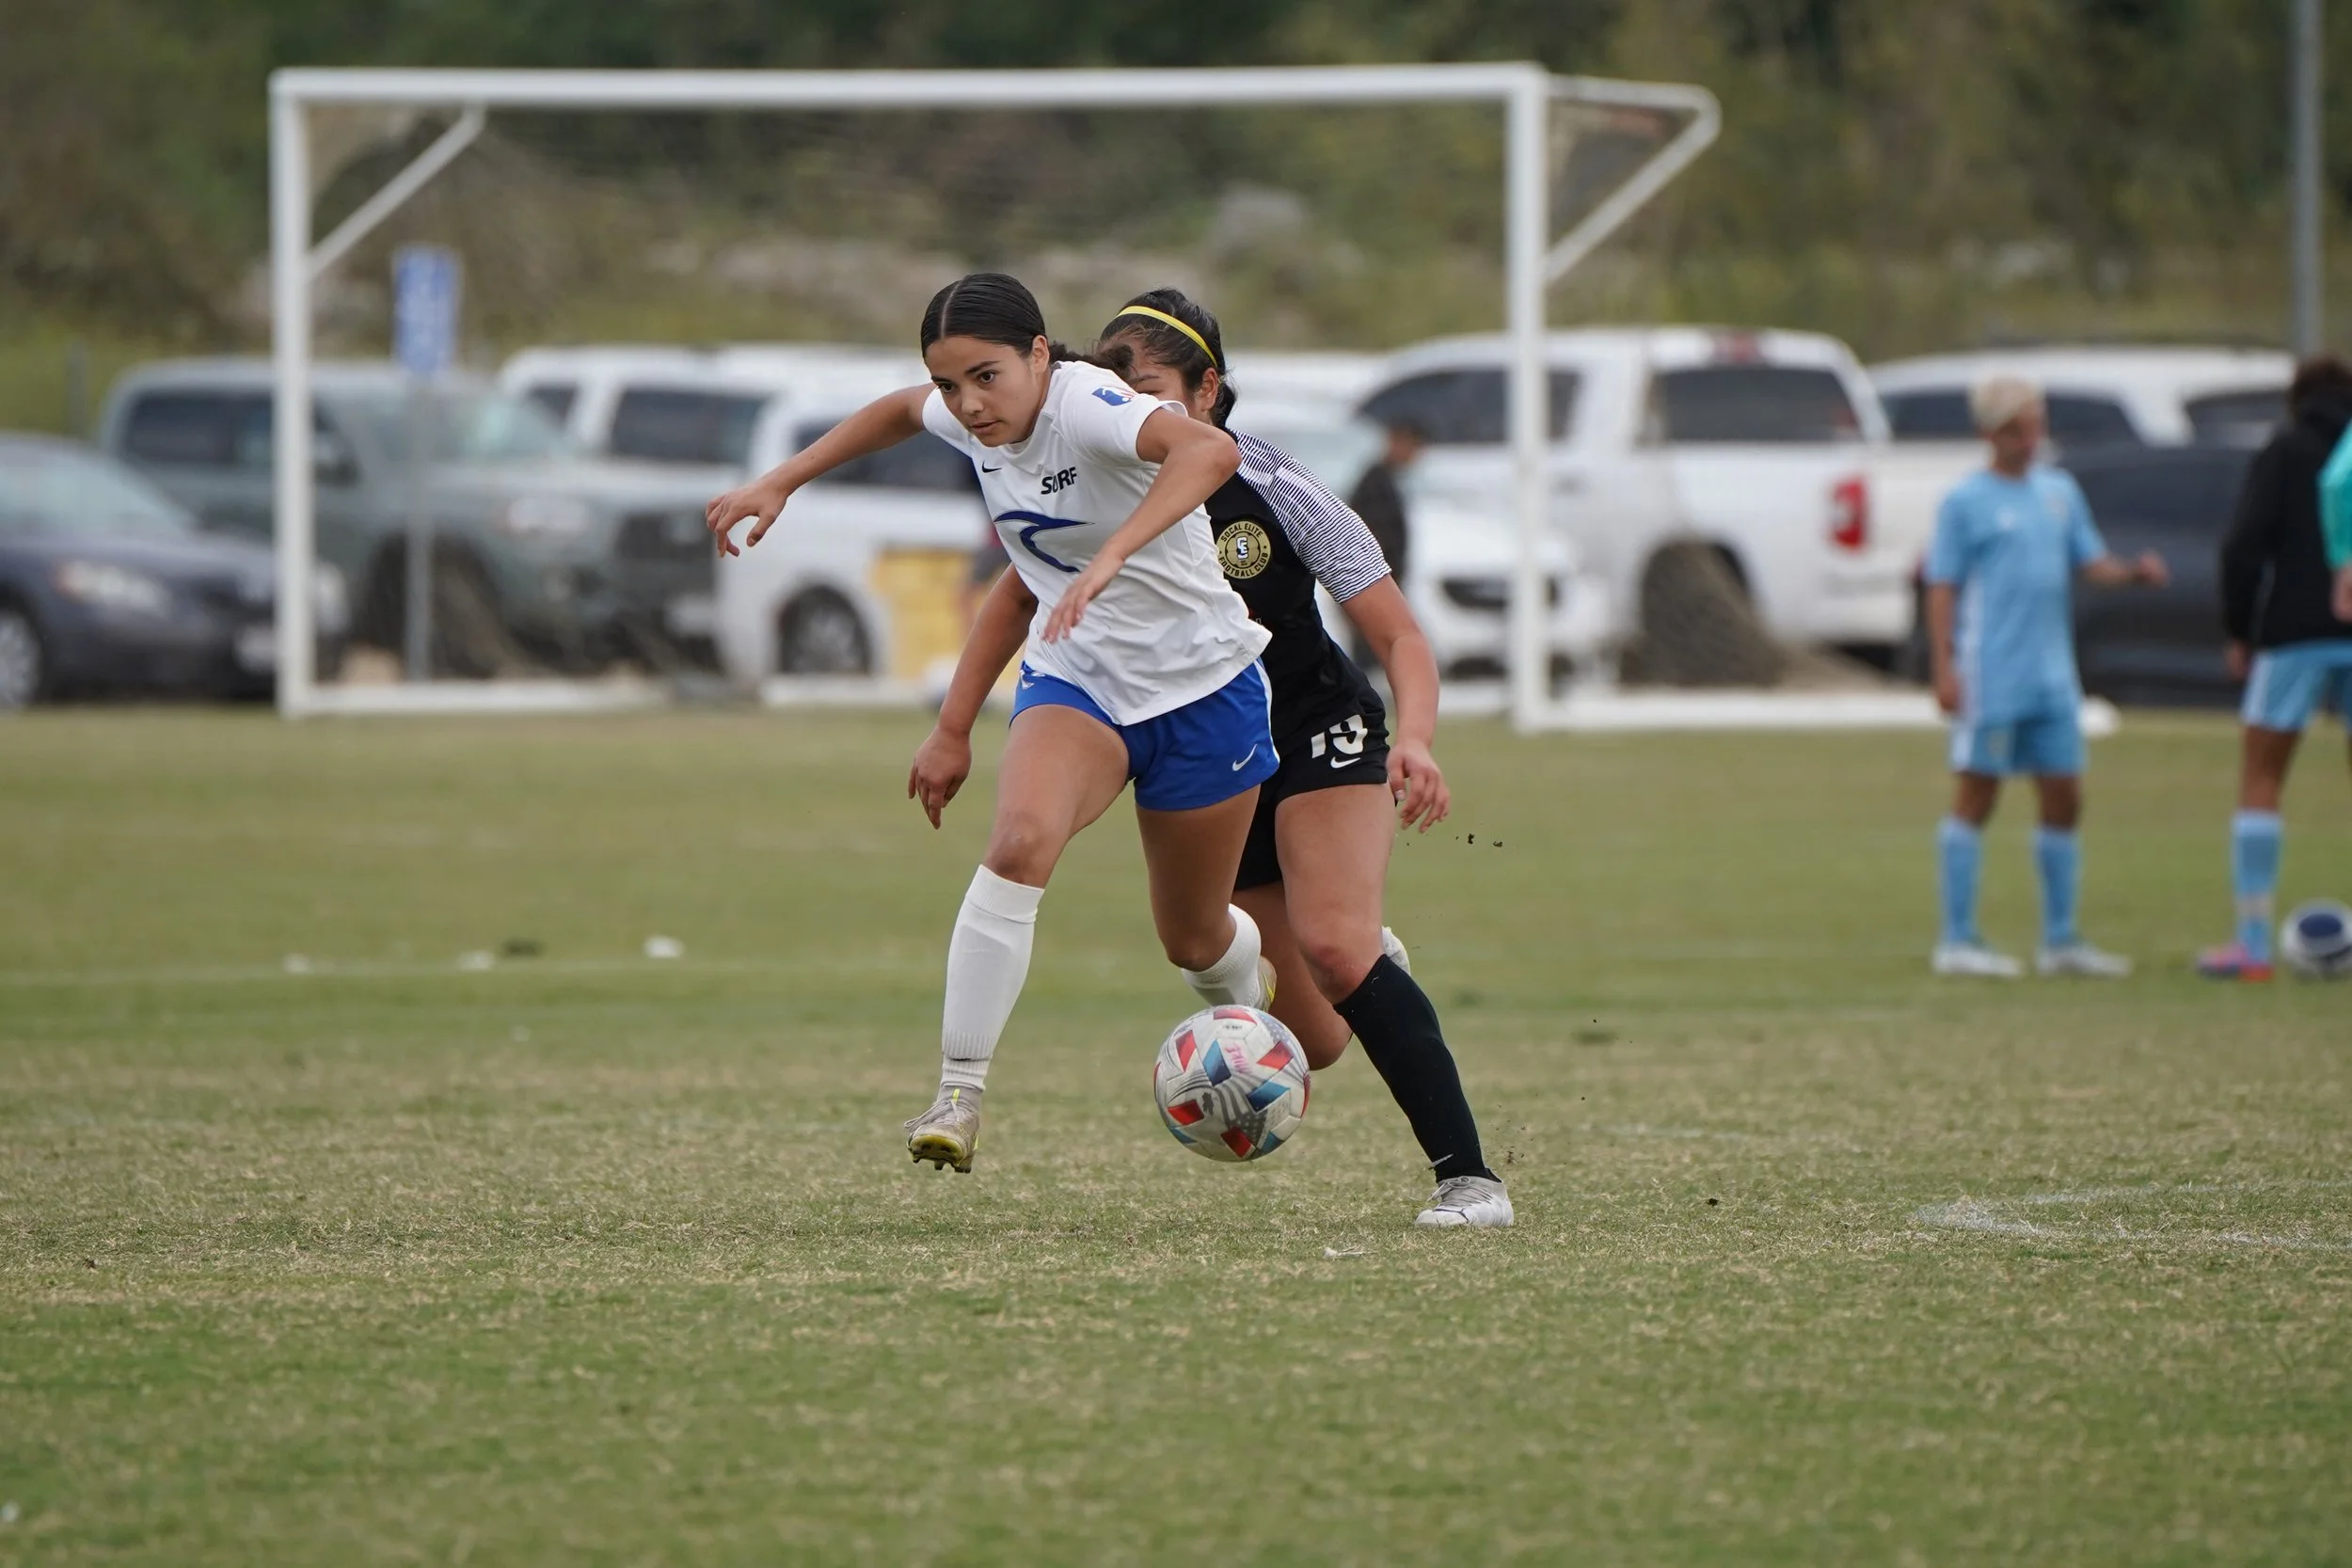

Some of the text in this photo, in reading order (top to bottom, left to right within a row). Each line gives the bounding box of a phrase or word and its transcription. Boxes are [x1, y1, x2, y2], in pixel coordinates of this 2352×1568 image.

[1220, 523, 1263, 542] SOCAL ELITE
[1218, 552, 1268, 578] FOOTBALL CLUB
[1311, 714, 1368, 758] 19
